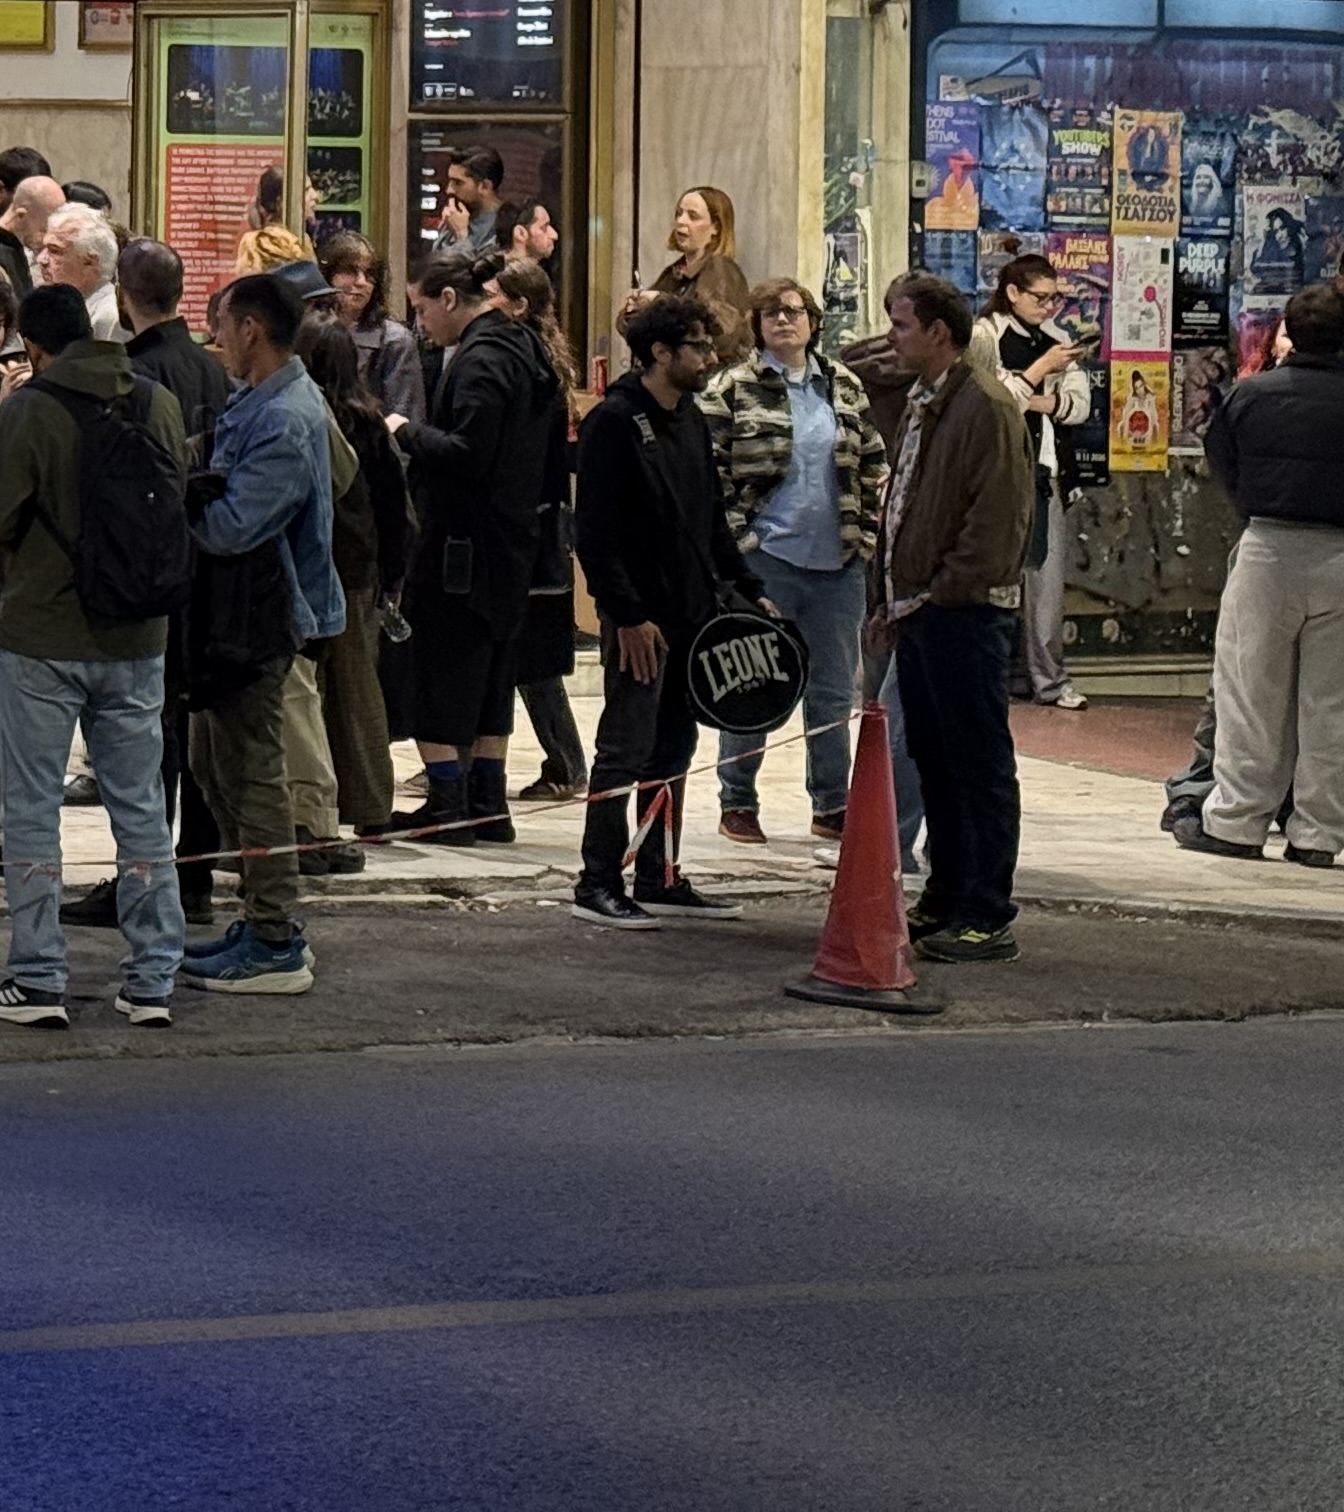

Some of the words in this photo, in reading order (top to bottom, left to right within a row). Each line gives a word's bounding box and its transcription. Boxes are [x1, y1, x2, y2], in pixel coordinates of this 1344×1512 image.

[1061, 142, 1102, 157] SHOW
[1187, 242, 1219, 258] DEEP
[1178, 256, 1226, 273] PURPLE
[697, 631, 790, 704] LEONE
